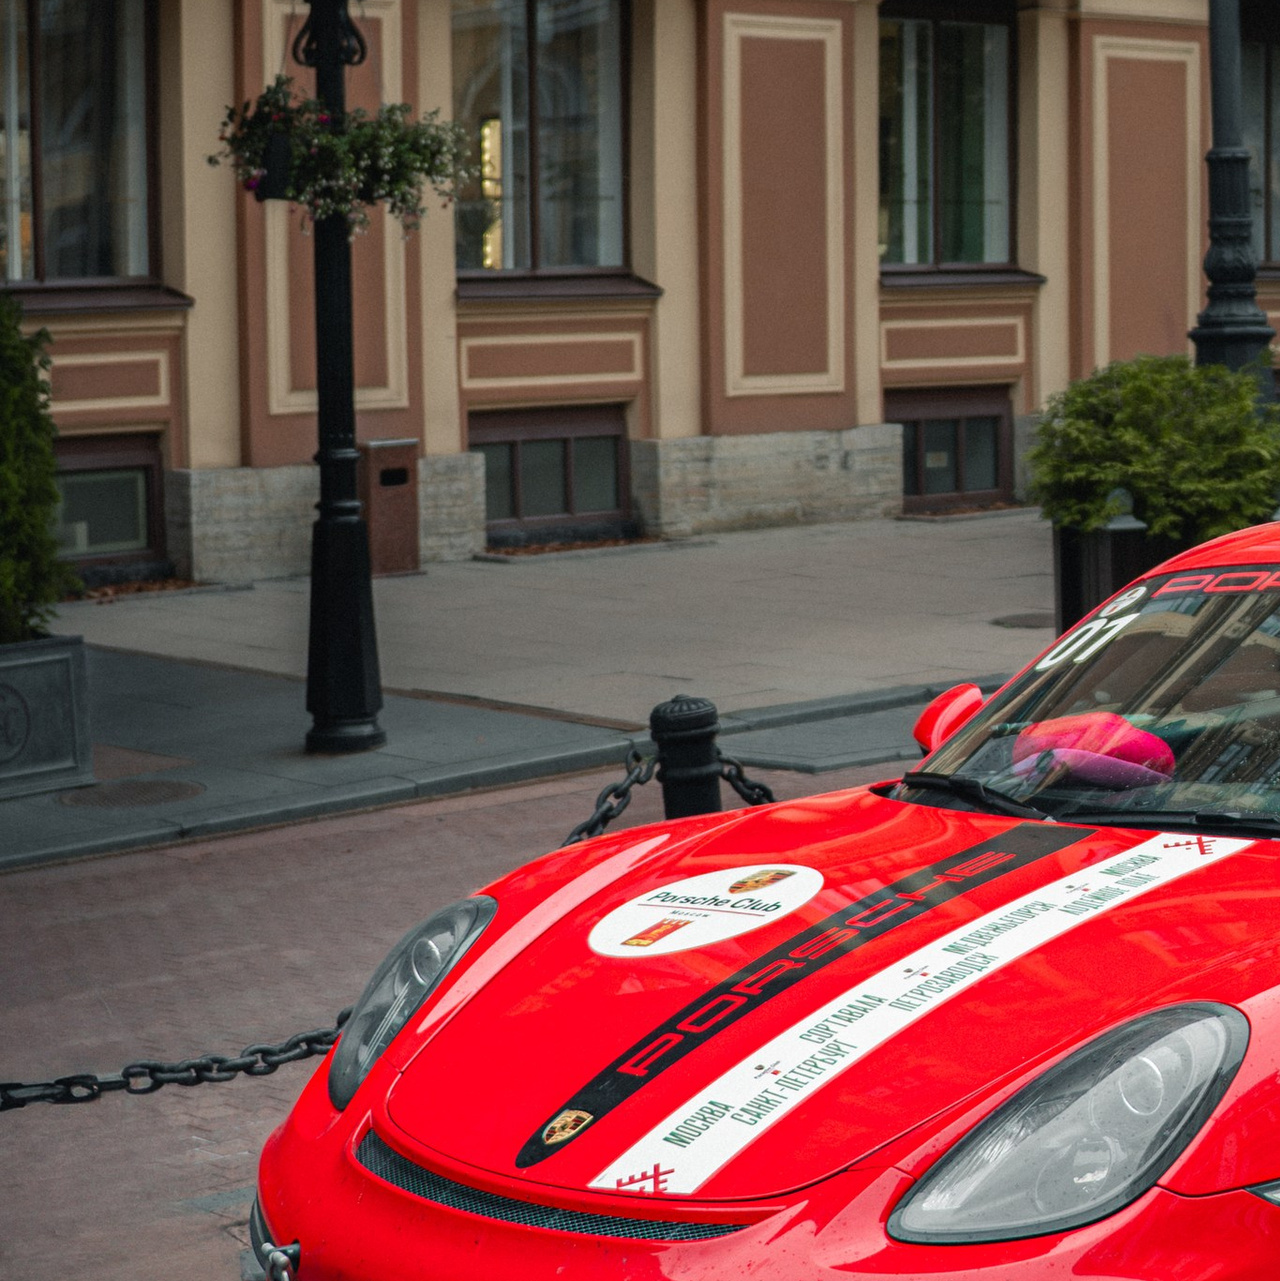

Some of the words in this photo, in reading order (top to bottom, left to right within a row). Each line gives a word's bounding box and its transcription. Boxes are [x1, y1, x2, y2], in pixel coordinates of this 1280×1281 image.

[1035, 612, 1140, 671] 01
[647, 891, 730, 908] Porsche
[730, 896, 783, 913] Club
[669, 909, 711, 919] Moscow
[942, 900, 1058, 958] МЕДВЕЖЬЕГОРСК
[616, 851, 1016, 1077] PORSCHE
[888, 951, 999, 1012] ПЕТРОЗАВОДСК
[799, 993, 888, 1045] СОРТАВАЛА
[662, 1100, 735, 1148] МОСКВА
